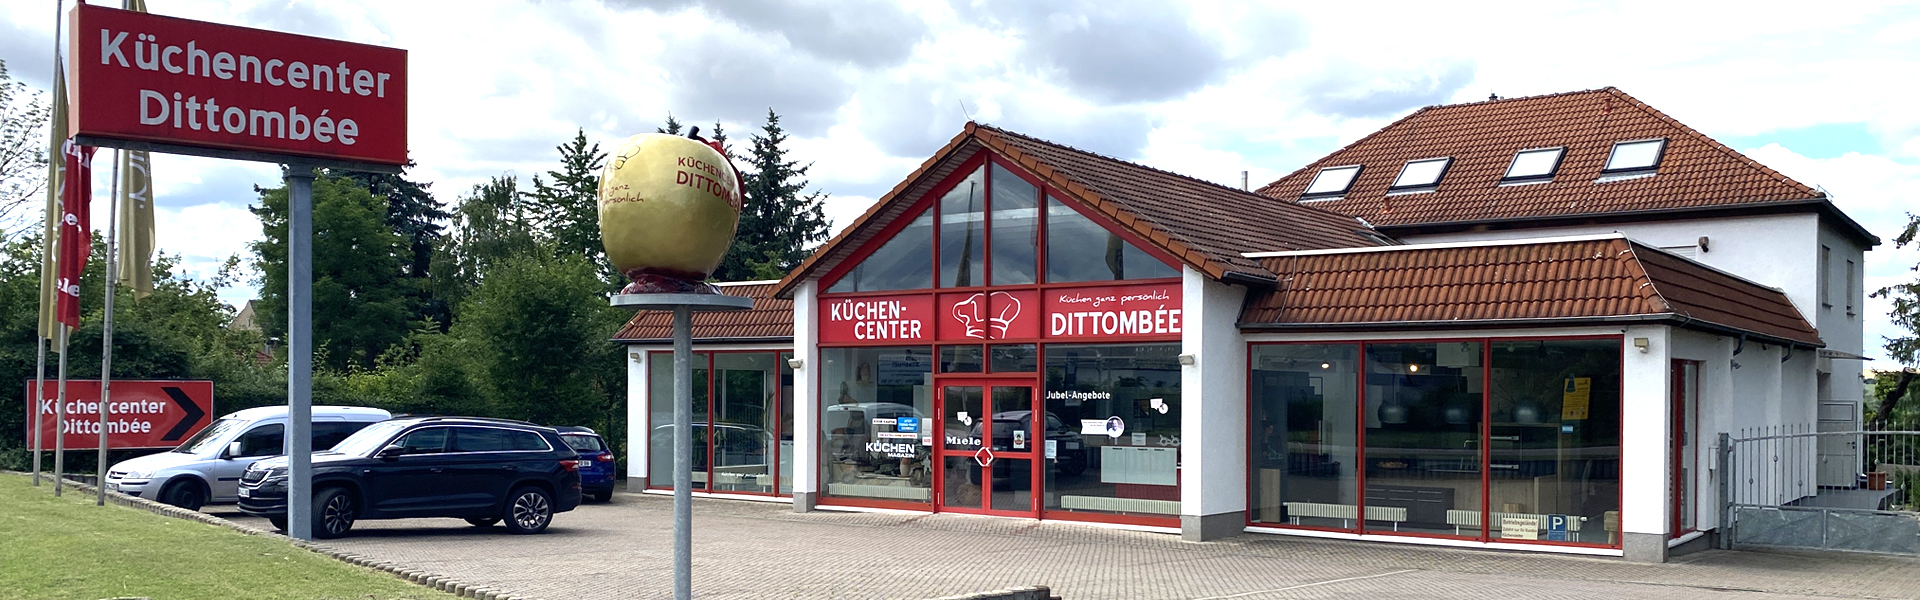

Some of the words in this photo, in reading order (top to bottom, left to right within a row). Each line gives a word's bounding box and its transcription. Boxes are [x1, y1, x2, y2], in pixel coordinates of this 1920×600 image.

[100, 29, 391, 98] Küchencenter
[139, 89, 360, 146] Dittombée
[609, 184, 630, 197] ganz
[1093, 294, 1117, 308] ganz
[831, 299, 907, 321] KÜCHEN-
[1051, 304, 1182, 336] DITTOMBÉE
[854, 319, 922, 340] CENTER
[1046, 390, 1111, 401] Jubel-Angebote
[946, 436, 982, 446] Miele
[1552, 516, 1564, 530] P
